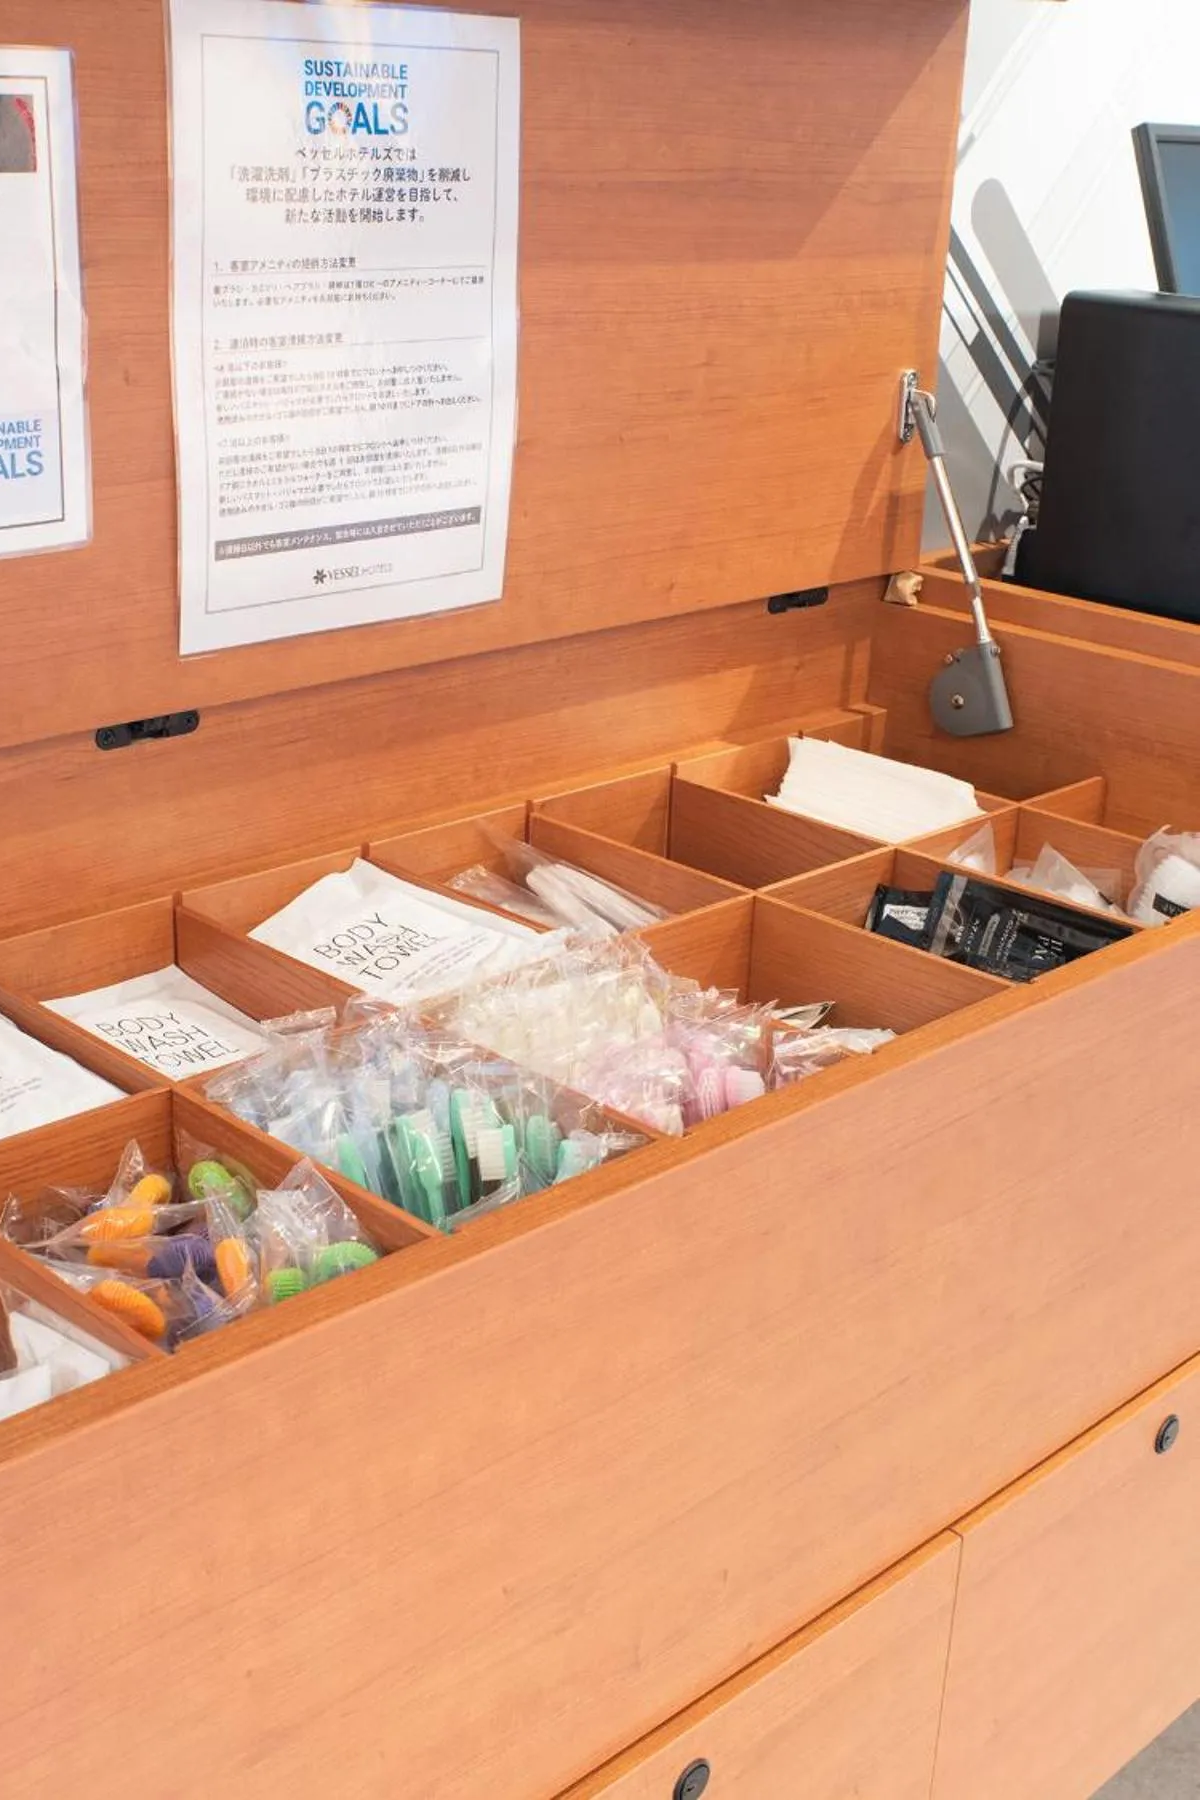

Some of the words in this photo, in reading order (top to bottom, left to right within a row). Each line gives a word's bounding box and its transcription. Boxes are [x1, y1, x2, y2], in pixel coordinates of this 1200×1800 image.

[304, 59, 408, 80] SUSTAINABLE
[305, 80, 408, 99] DEVELOPMENT
[305, 100, 409, 135] GOALS
[313, 912, 388, 960] BODY
[95, 1012, 182, 1037] BODY
[117, 1024, 209, 1053] WASH
[137, 1040, 240, 1067] TOWEL
